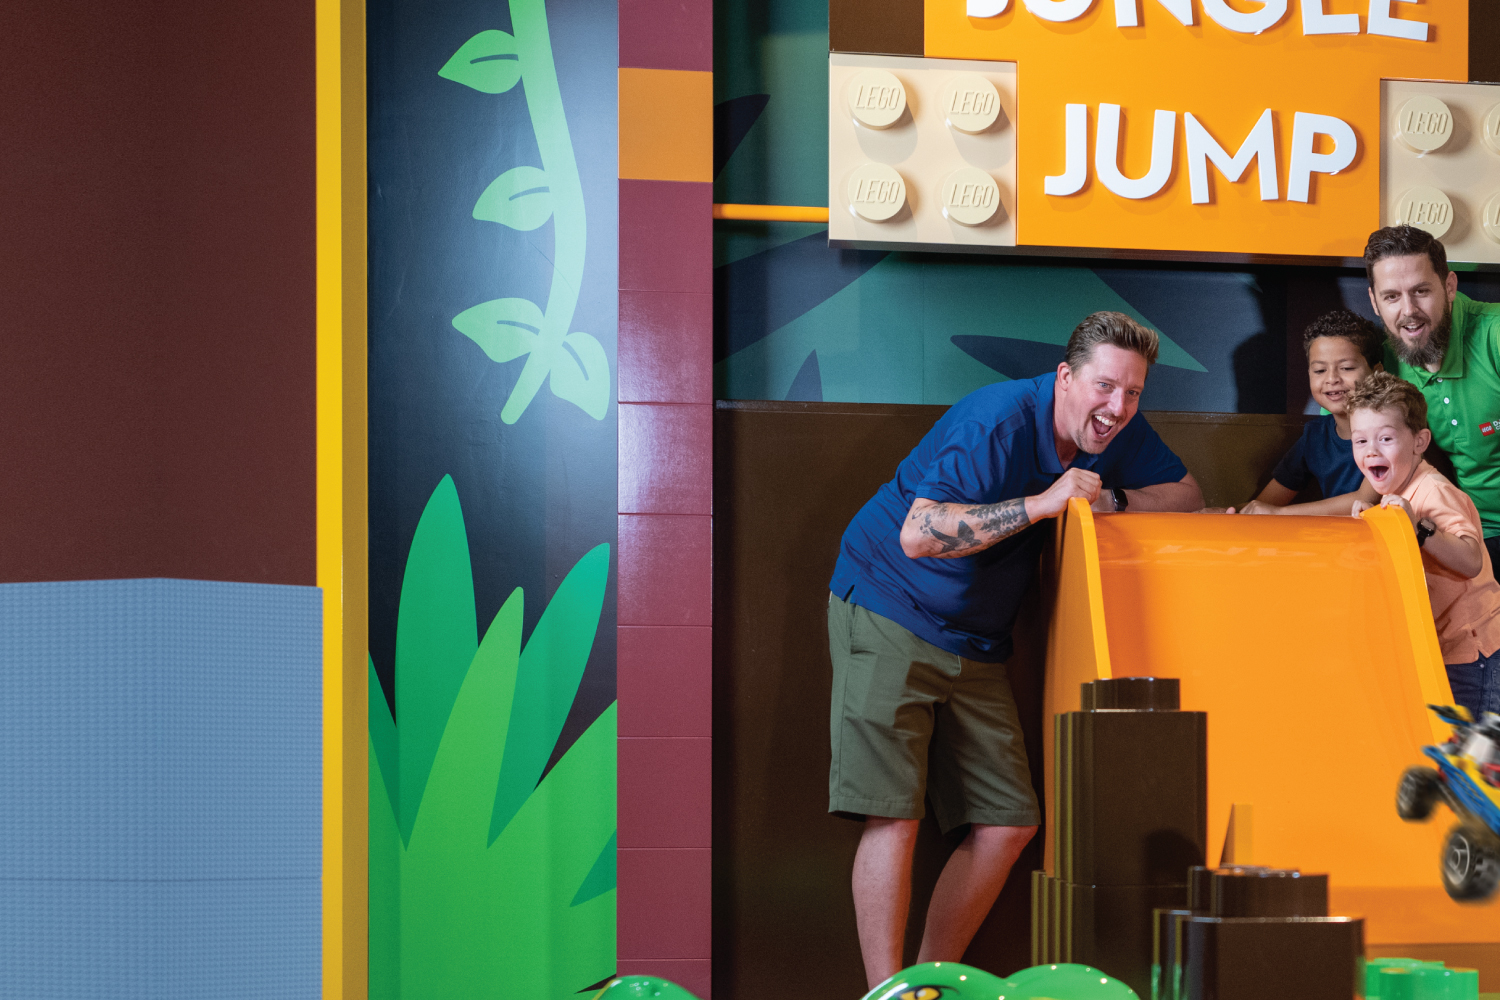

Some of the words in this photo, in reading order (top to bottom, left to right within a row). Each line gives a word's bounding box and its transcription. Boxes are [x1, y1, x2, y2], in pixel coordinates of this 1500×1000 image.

[855, 84, 901, 111] LEGO
[950, 89, 995, 116] LEGO
[1404, 110, 1449, 135] LEGO
[1044, 102, 1357, 205] JUMP
[854, 178, 901, 204] LEGO
[949, 183, 995, 209] LEGO
[1403, 201, 1449, 225] LEGO
